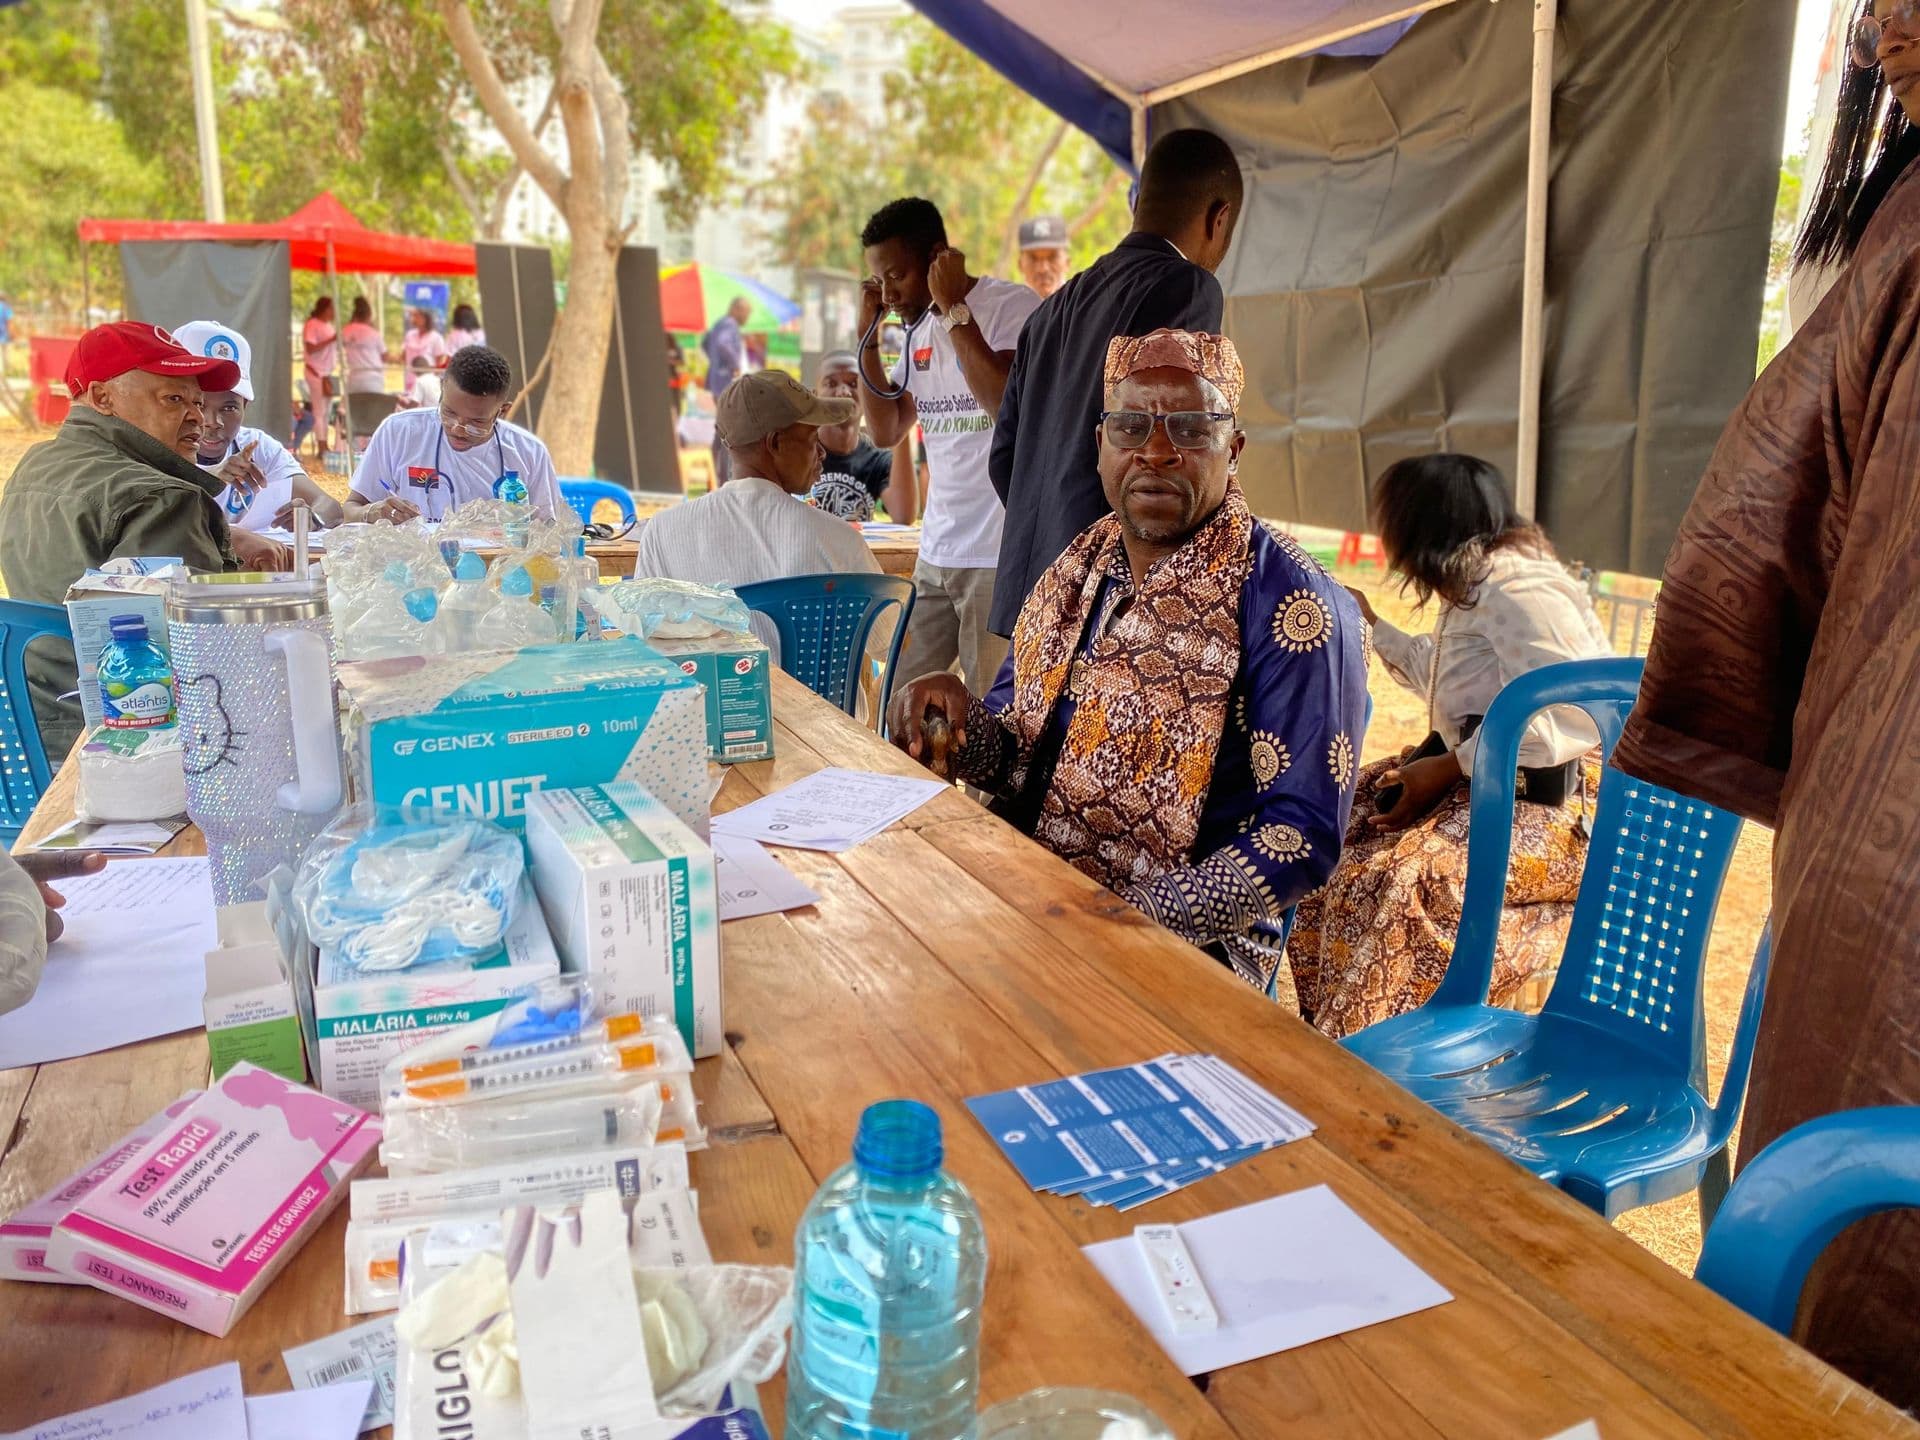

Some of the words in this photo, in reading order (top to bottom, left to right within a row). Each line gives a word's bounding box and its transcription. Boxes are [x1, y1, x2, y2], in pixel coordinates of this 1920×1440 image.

[121, 695, 168, 710] atlantis
[421, 732, 496, 753] GENEX
[508, 728, 551, 744] STERILE
[555, 727, 573, 738] EO
[601, 716, 638, 734] 10ml
[670, 869, 688, 942] MALÁRIA
[333, 1013, 417, 1036] MALÁRIA
[455, 1010, 470, 1020] Ag
[119, 1167, 165, 1199] Test
[155, 1122, 211, 1169] Rapid
[142, 1197, 168, 1219] 99%
[166, 1159, 209, 1200] resultado
[206, 1129, 239, 1161] preciso
[161, 1174, 216, 1226] Identificação
[213, 1161, 230, 1176] em
[224, 1153, 236, 1163] 5
[232, 1131, 260, 1157] minuto
[244, 1233, 277, 1263] TESTE
[268, 1223, 287, 1240] DE
[278, 1185, 320, 1227] GRAVIDEZ
[87, 1260, 114, 1279] TEST
[119, 1275, 189, 1311] PREGNANCY
